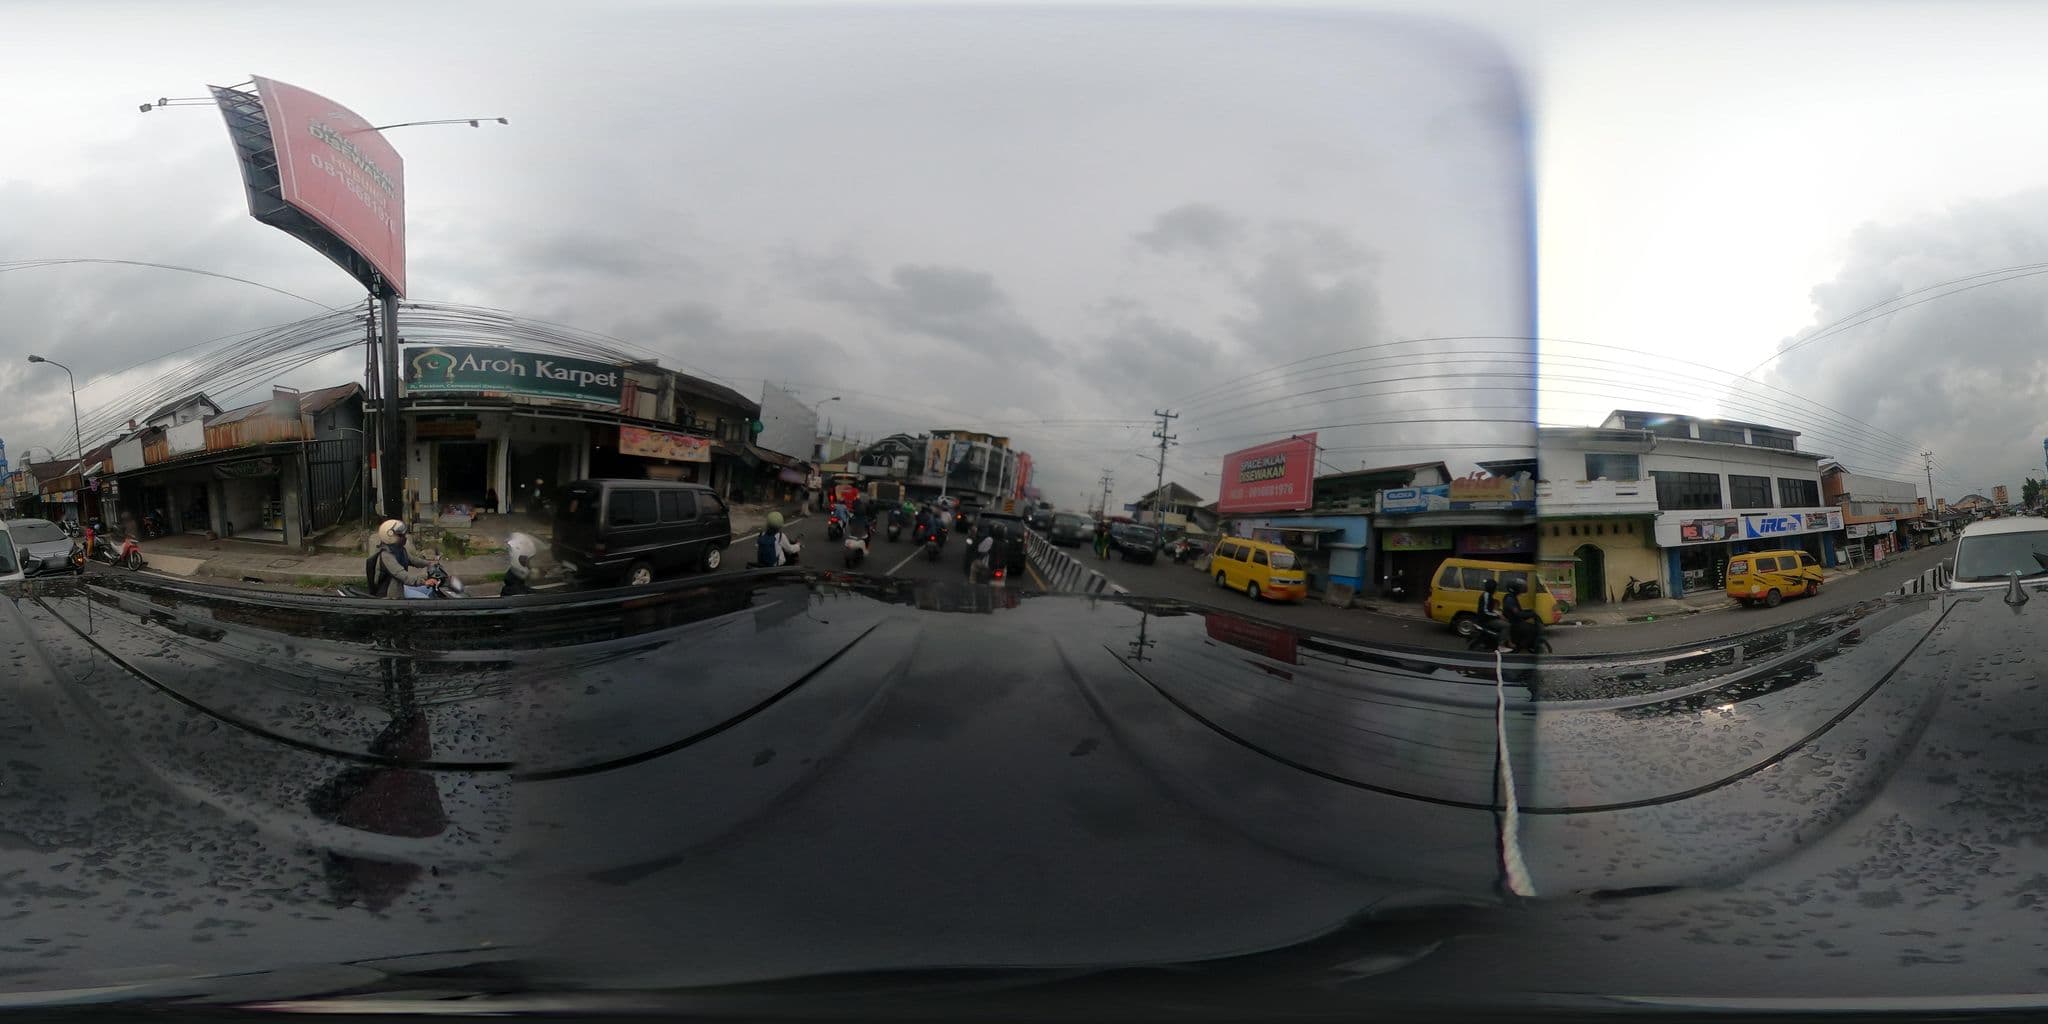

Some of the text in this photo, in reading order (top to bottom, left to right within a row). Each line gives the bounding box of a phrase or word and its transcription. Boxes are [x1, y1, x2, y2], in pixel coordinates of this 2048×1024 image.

[458, 352, 618, 387] Aroh Karpet
[1240, 465, 1286, 482] DISEWAKAN
